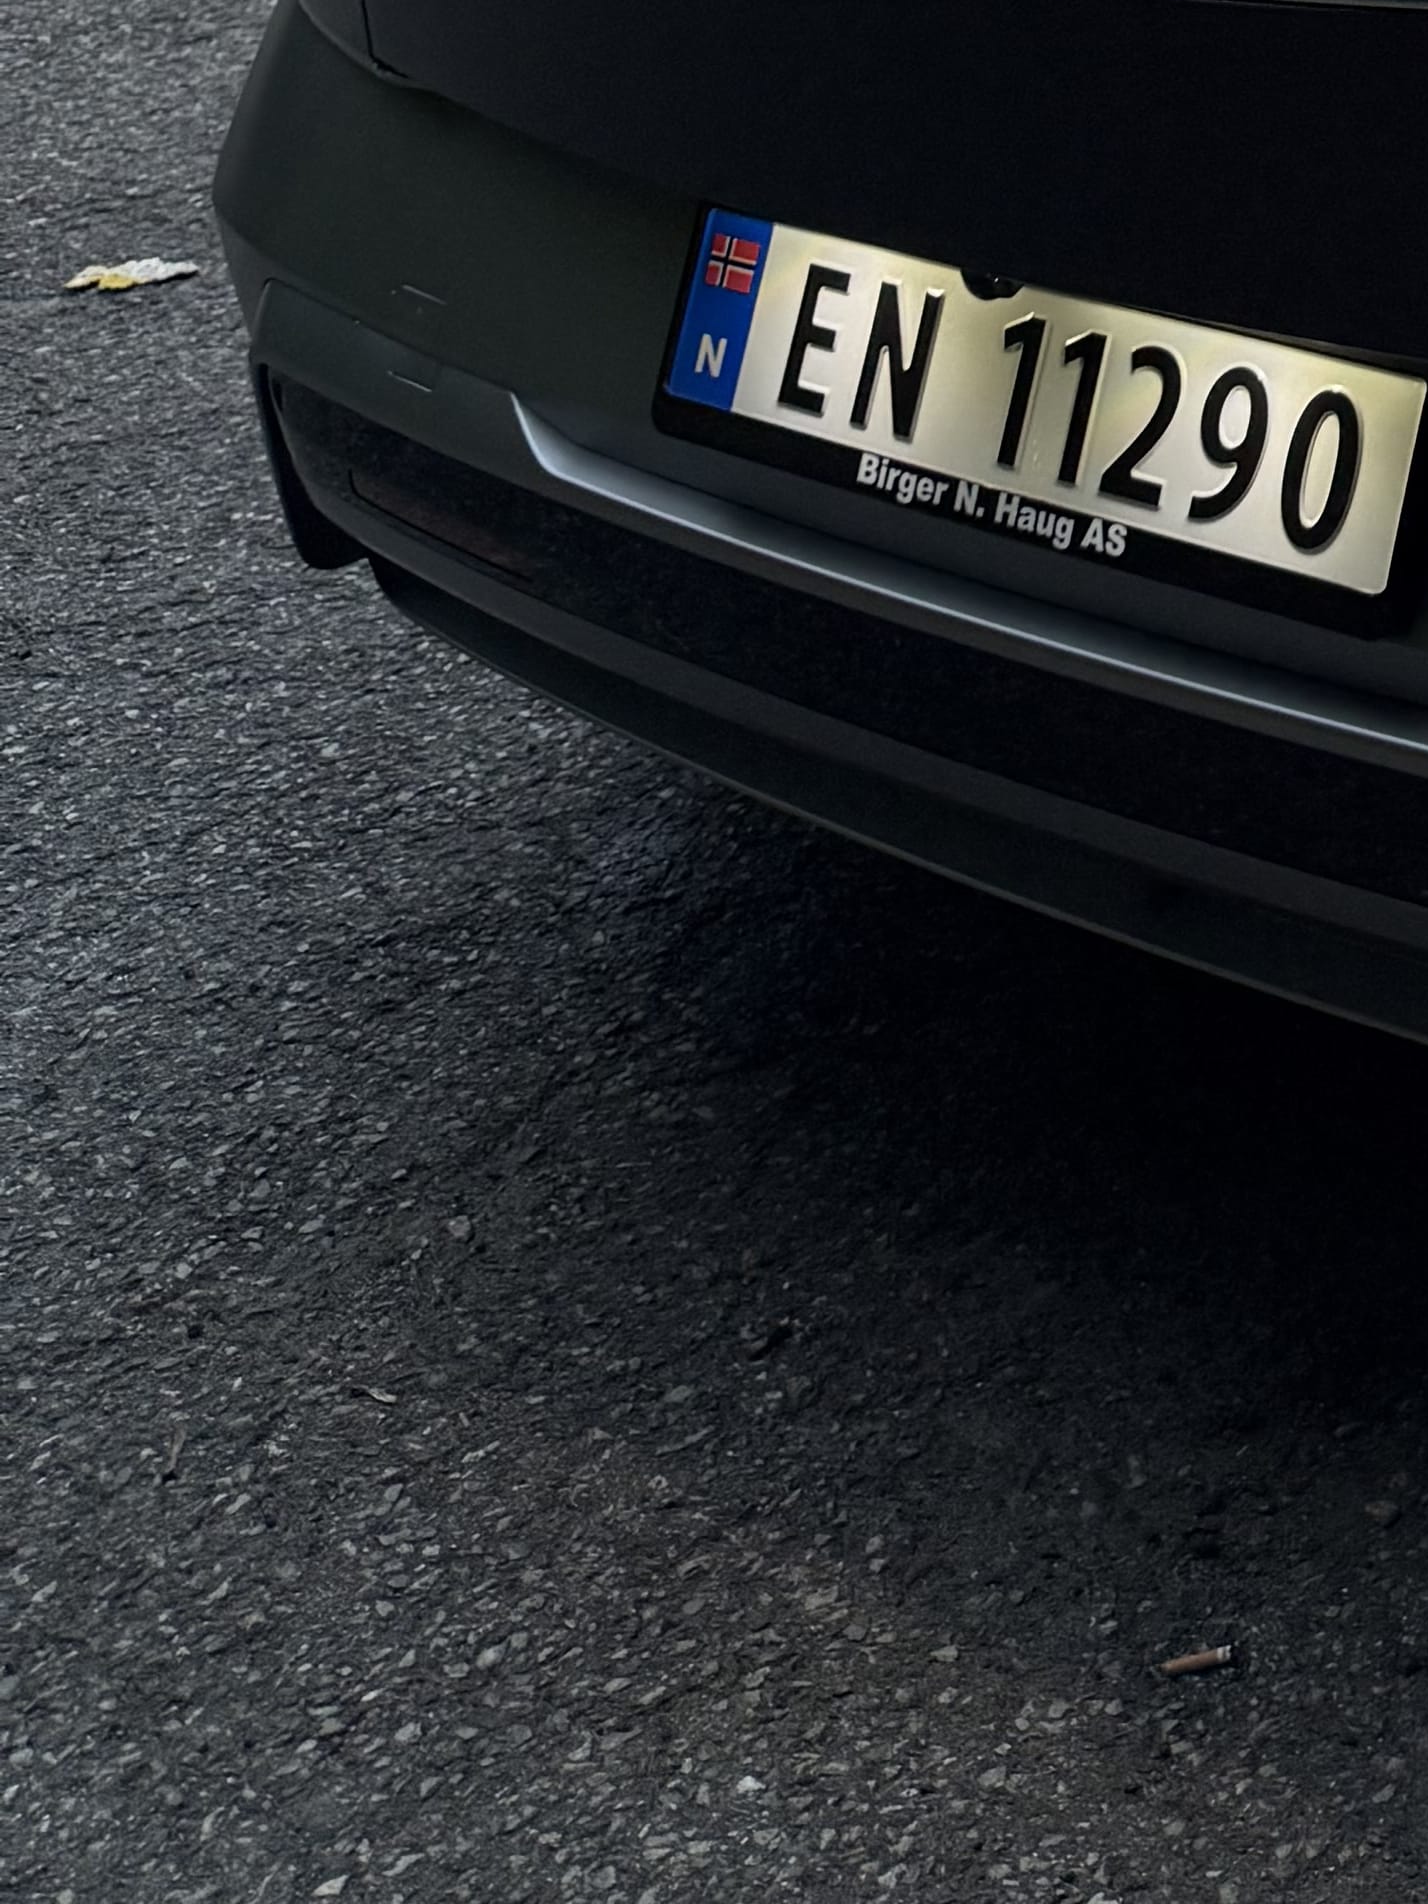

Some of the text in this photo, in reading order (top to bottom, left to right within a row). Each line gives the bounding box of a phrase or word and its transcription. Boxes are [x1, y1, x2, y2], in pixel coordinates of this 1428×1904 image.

[693, 333, 728, 379] N
[777, 263, 1364, 551] EN 11290
[856, 453, 1129, 558] Birger N. Haug AS
